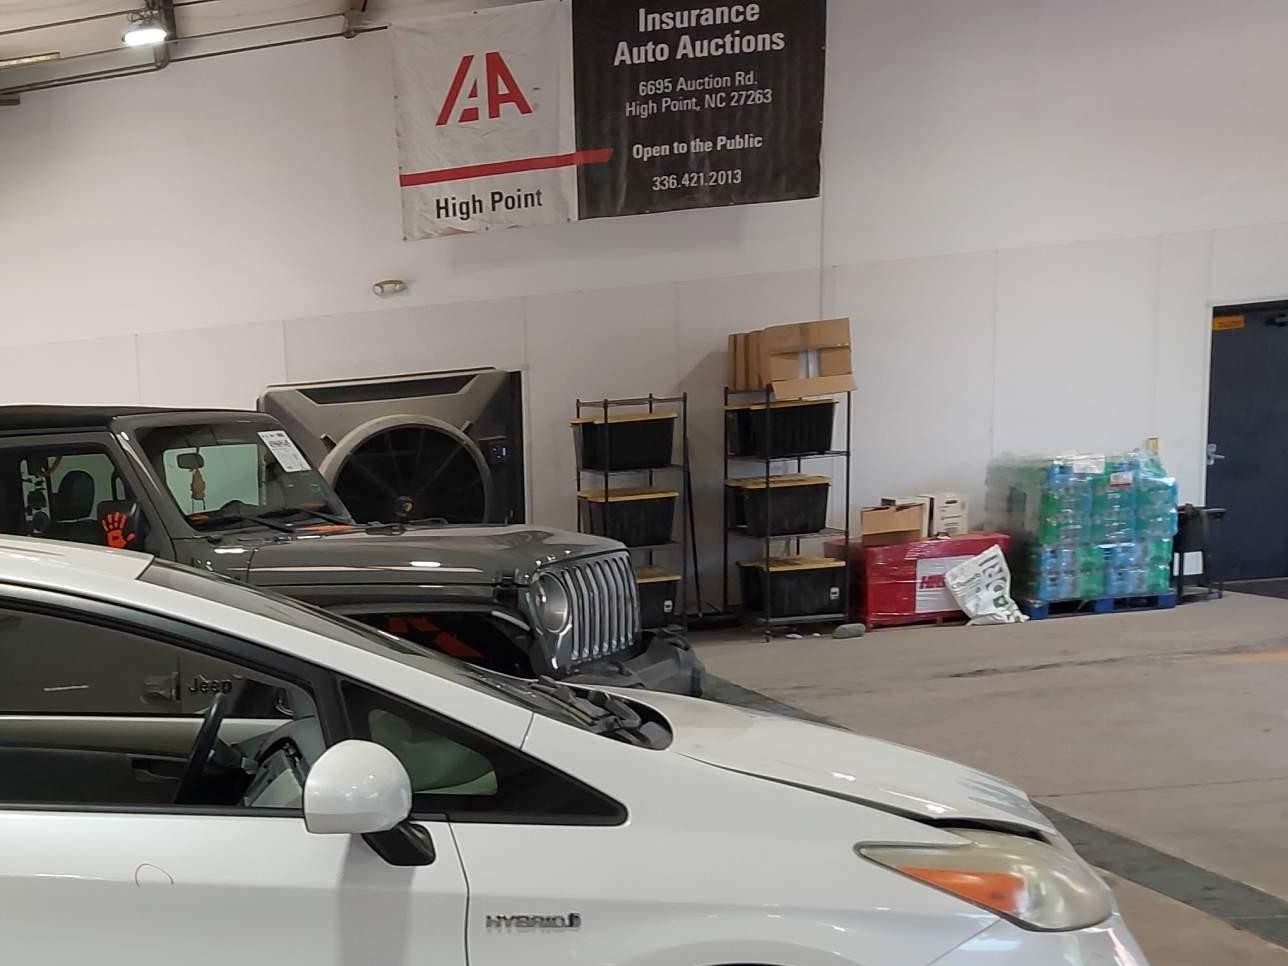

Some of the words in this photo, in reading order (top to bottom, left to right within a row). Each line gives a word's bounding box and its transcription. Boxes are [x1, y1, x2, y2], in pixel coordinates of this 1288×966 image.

[638, 3, 760, 32] Insurance
[613, 40, 669, 66] Auto
[675, 30, 785, 59] Auctions
[638, 78, 673, 96] 6695
[676, 74, 731, 91] Auction
[735, 70, 758, 86] Rd.
[625, 101, 657, 118] High
[662, 96, 701, 112] Point,
[704, 92, 726, 108] NC
[730, 88, 773, 106] 27263
[632, 142, 670, 161] Open
[672, 141, 688, 154] to
[690, 138, 713, 153] the
[716, 133, 763, 151] Public
[651, 169, 742, 191] 336.421.2013
[435, 194, 483, 221] High
[490, 188, 543, 212] Point
[188, 678, 232, 695] Jeep
